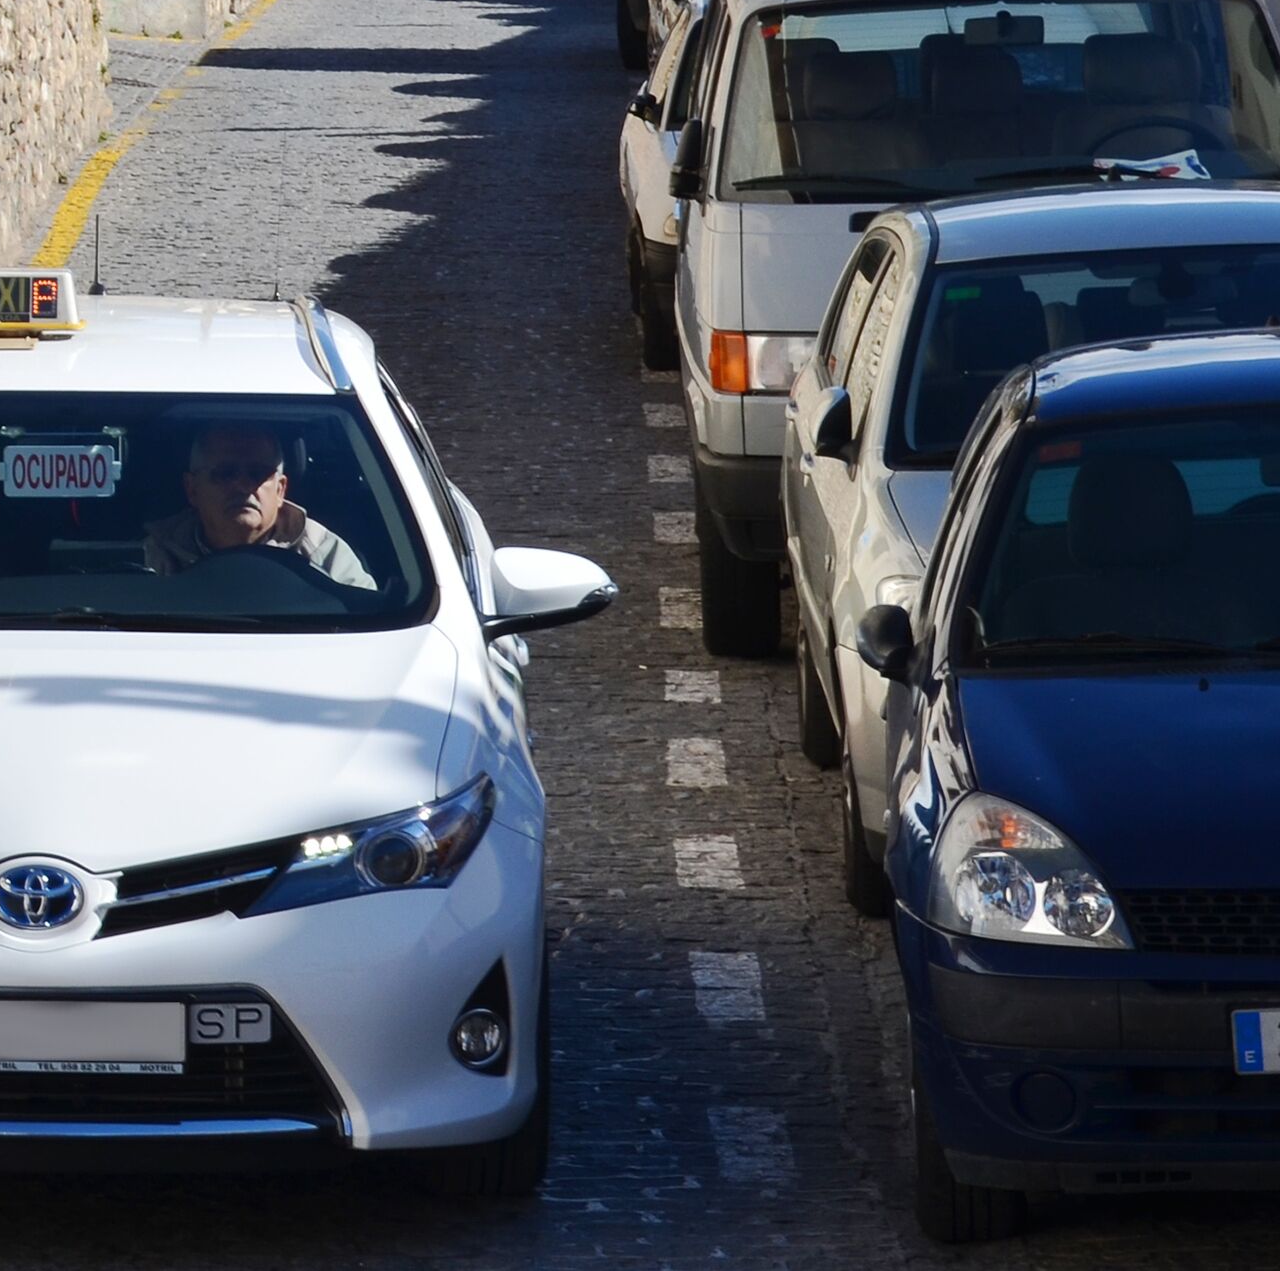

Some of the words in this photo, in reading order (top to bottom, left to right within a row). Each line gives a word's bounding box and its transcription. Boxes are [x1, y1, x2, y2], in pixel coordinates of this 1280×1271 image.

[11, 453, 108, 490] OCUPADO
[1244, 1050, 1256, 1064] E
[139, 1064, 176, 1072] MOTRIL
